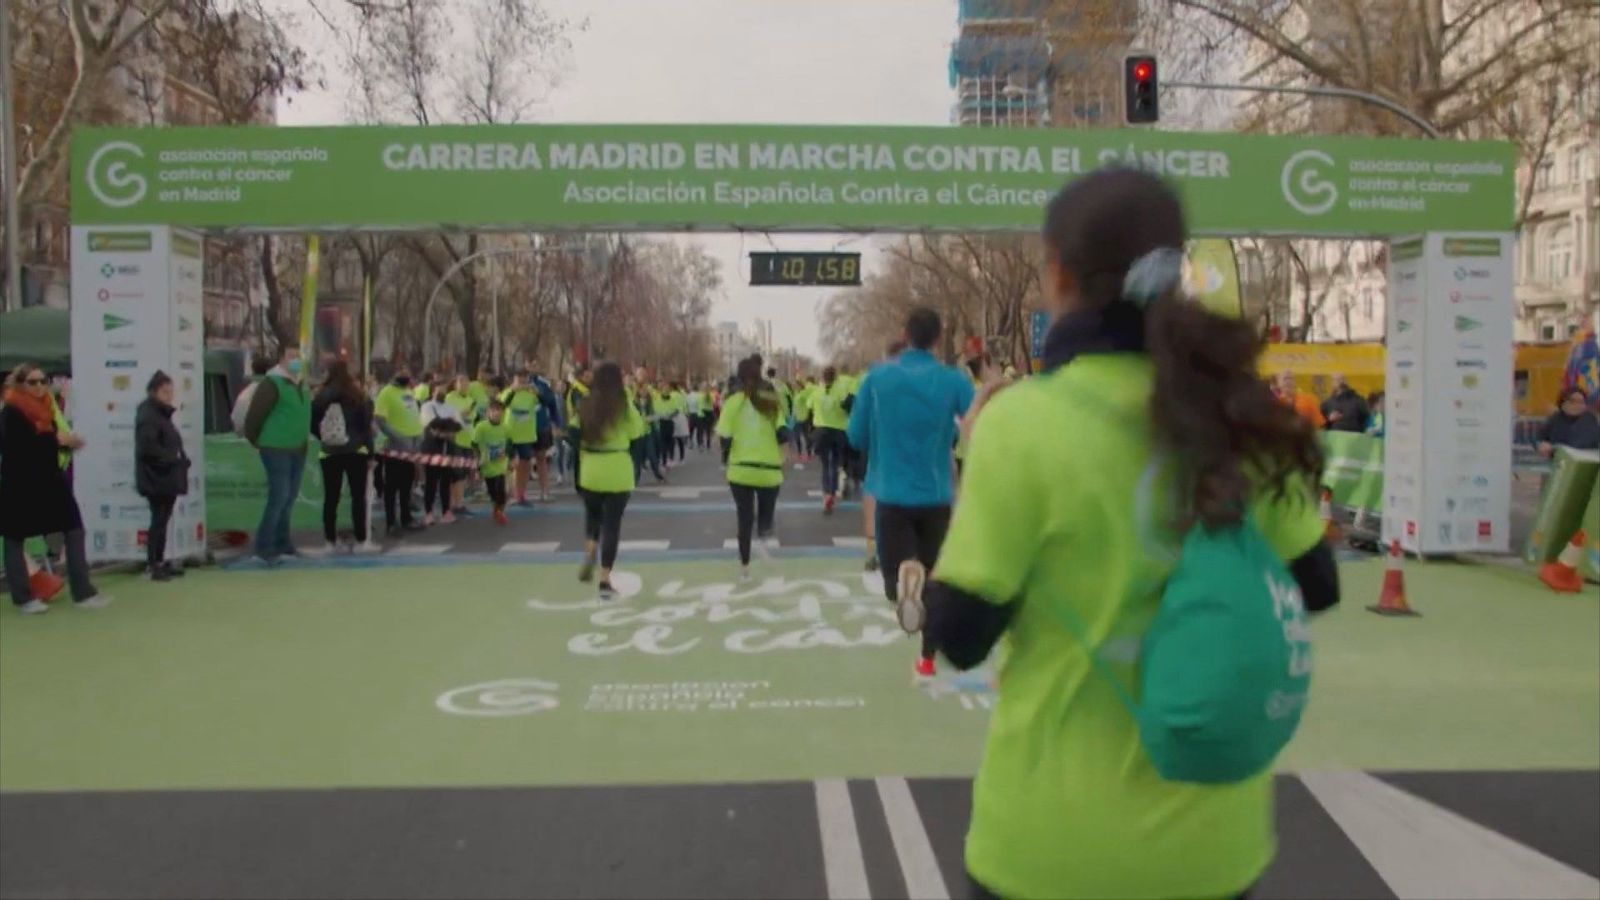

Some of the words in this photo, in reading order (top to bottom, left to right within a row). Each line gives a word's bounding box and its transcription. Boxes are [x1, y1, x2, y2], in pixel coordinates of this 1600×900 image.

[382, 143, 542, 170] CARRERA
[549, 142, 686, 170] MADRID
[694, 143, 739, 169] EN
[749, 143, 896, 170] MARCHA
[903, 145, 1043, 172] CONTRA
[1051, 147, 1085, 174] EL
[183, 186, 241, 202] Madrid
[563, 180, 706, 204] Asociación
[714, 180, 834, 208] Española
[841, 182, 928, 205] Contra
[936, 182, 958, 205] el
